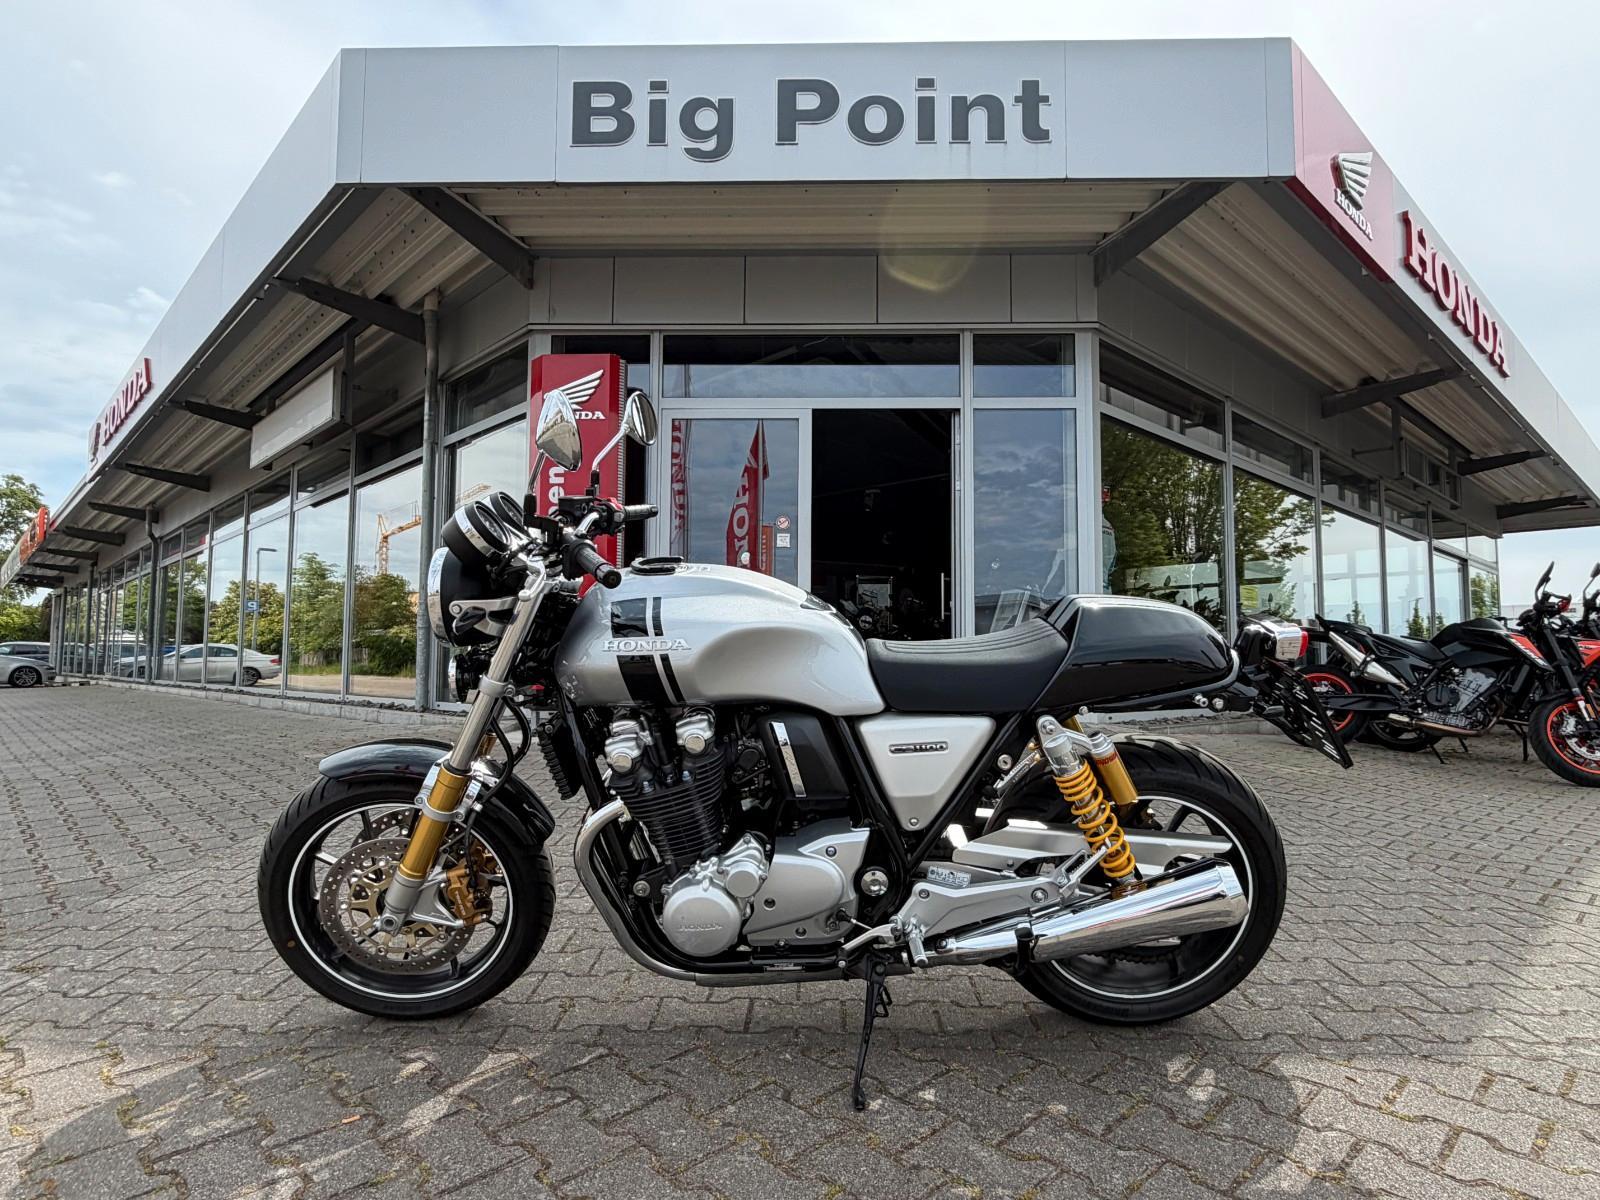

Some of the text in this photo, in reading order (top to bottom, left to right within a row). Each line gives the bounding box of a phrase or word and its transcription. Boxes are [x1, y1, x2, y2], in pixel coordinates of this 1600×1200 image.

[570, 76, 1053, 162] Big Point
[1334, 188, 1373, 240] HONDA
[1402, 210, 1510, 377] HONDA
[103, 358, 151, 446] HONDA
[575, 411, 606, 420] NDA
[602, 638, 692, 652] HONDA
